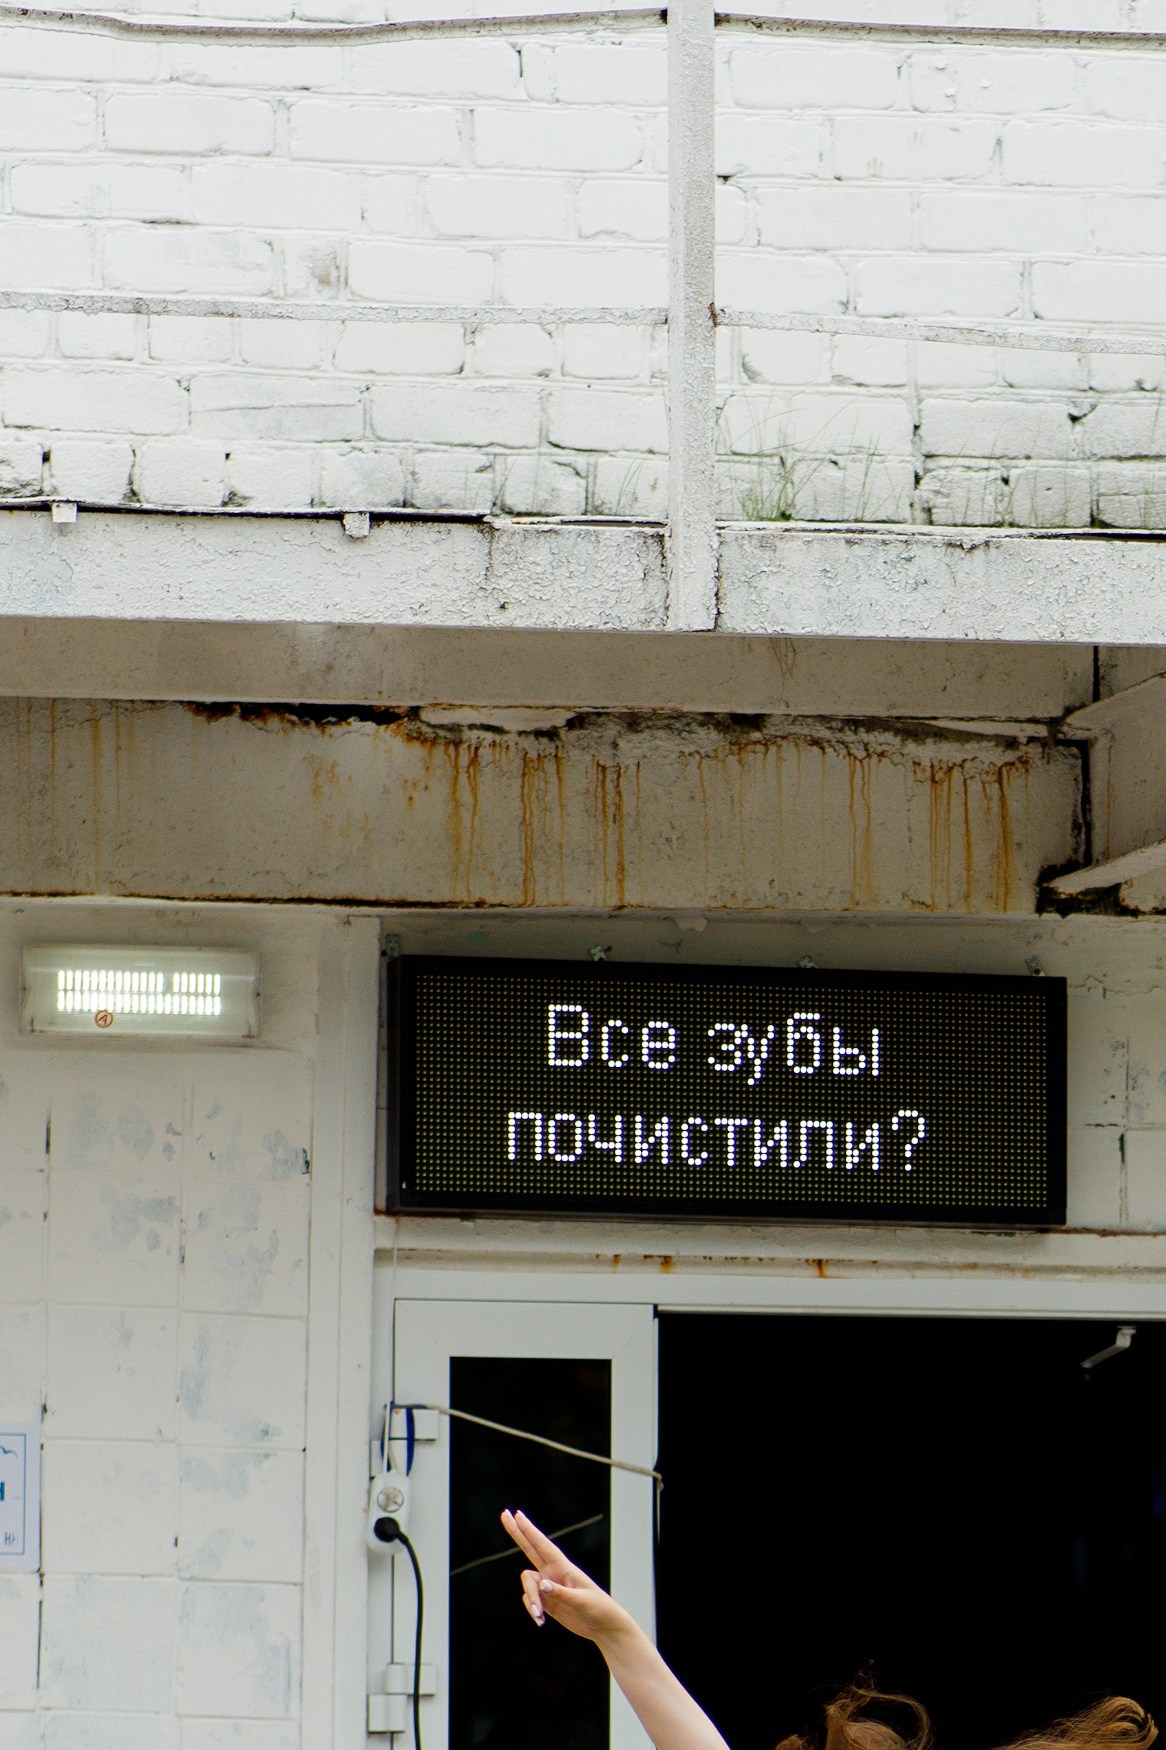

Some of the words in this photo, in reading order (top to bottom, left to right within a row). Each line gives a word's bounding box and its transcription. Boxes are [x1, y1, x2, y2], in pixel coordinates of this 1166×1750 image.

[548, 1004, 676, 1069] Все
[707, 1012, 880, 1085] зубы
[507, 1110, 926, 1172] почистили?
